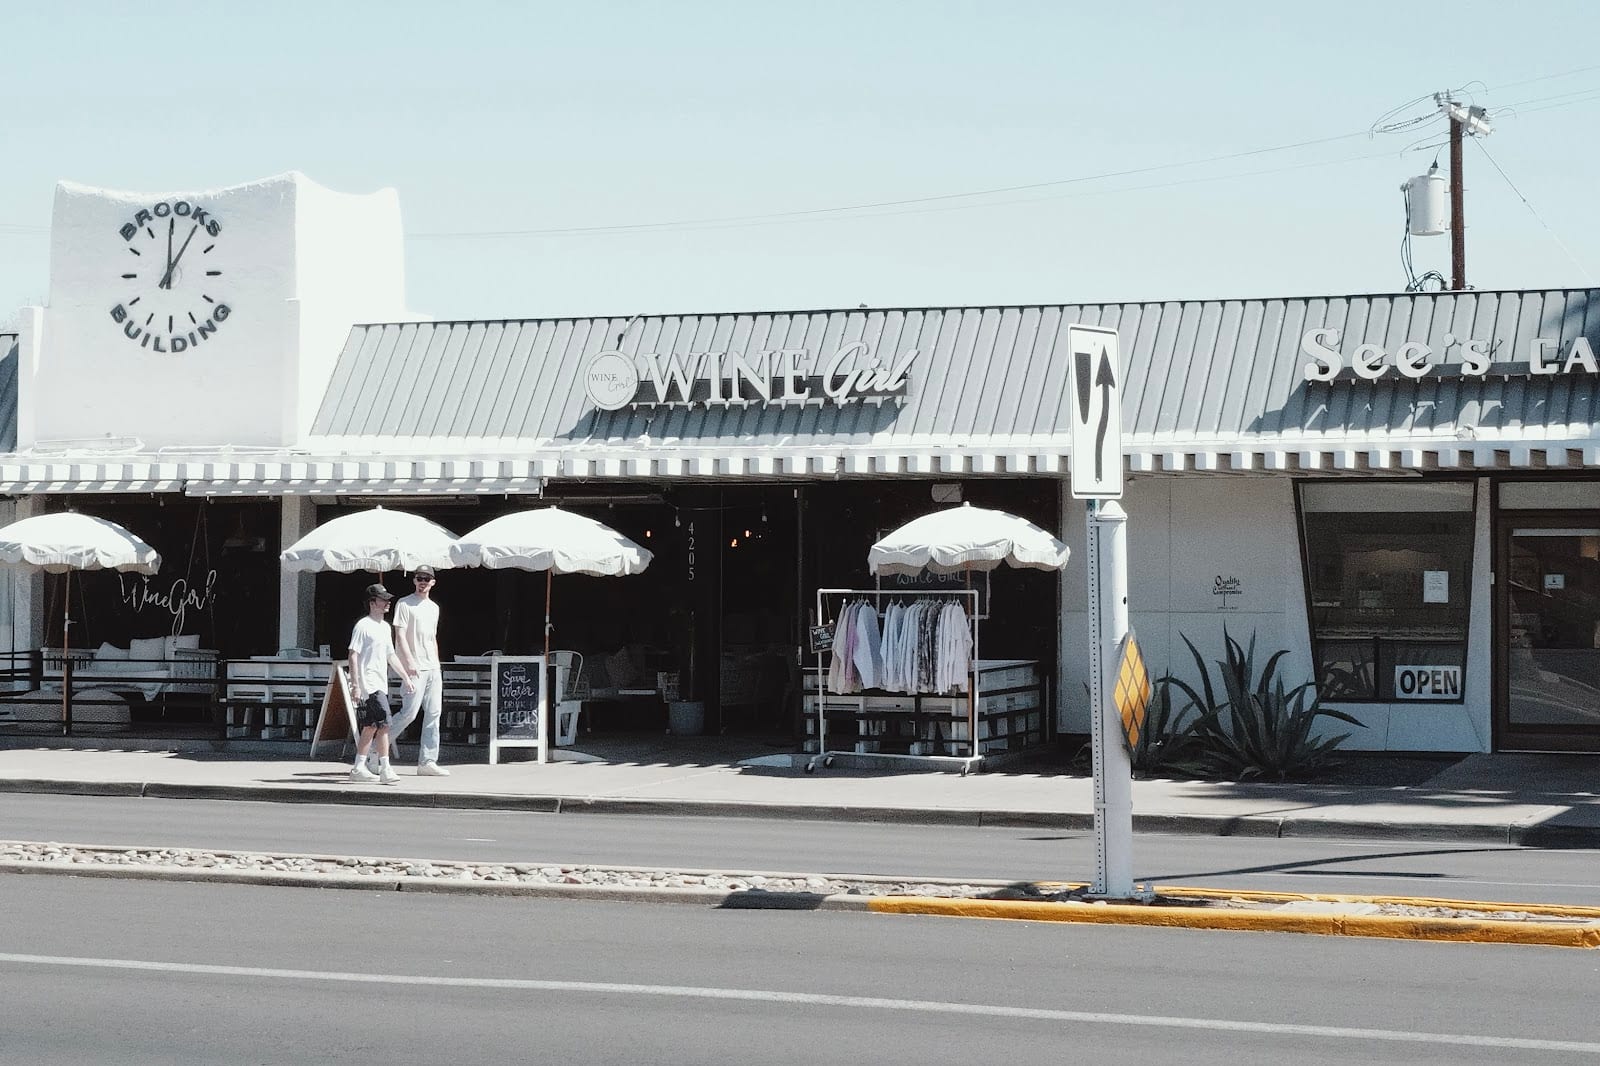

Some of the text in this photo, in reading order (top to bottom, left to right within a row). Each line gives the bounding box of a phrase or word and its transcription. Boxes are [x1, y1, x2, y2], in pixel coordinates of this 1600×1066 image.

[119, 201, 222, 242] BROOKS
[110, 304, 232, 353] BUILDING
[643, 341, 920, 405] WINE Girl
[1301, 328, 1492, 382] See's
[591, 373, 617, 382] WINE
[502, 671, 531, 686] Save
[1400, 669, 1458, 695] OPEN
